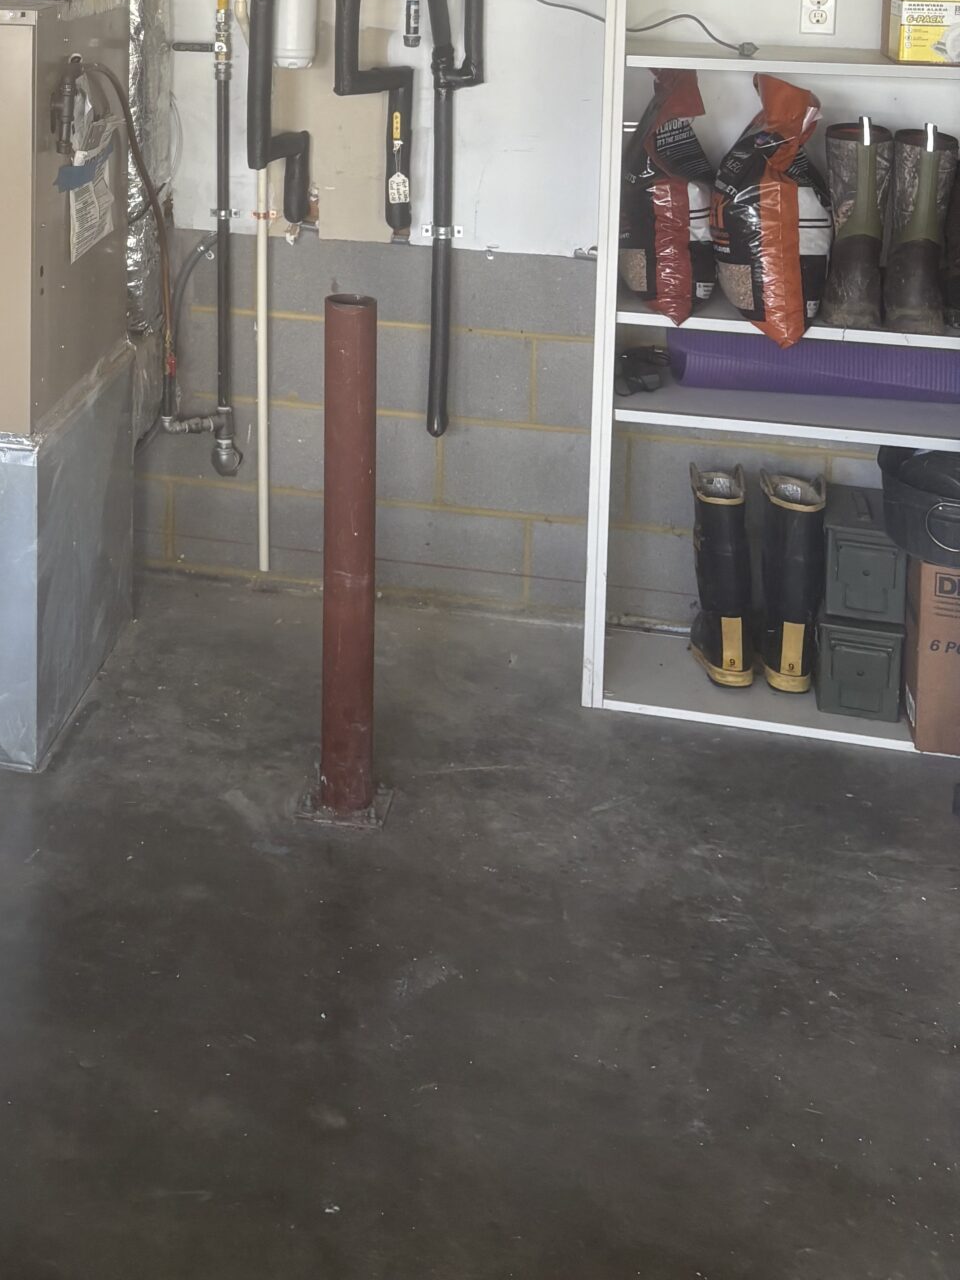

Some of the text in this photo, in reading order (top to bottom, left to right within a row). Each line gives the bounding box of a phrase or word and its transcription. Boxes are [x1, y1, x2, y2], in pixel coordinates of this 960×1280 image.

[906, 15, 945, 23] 6-PACK
[939, 575, 960, 597] D
[930, 639, 960, 655] 6 P
